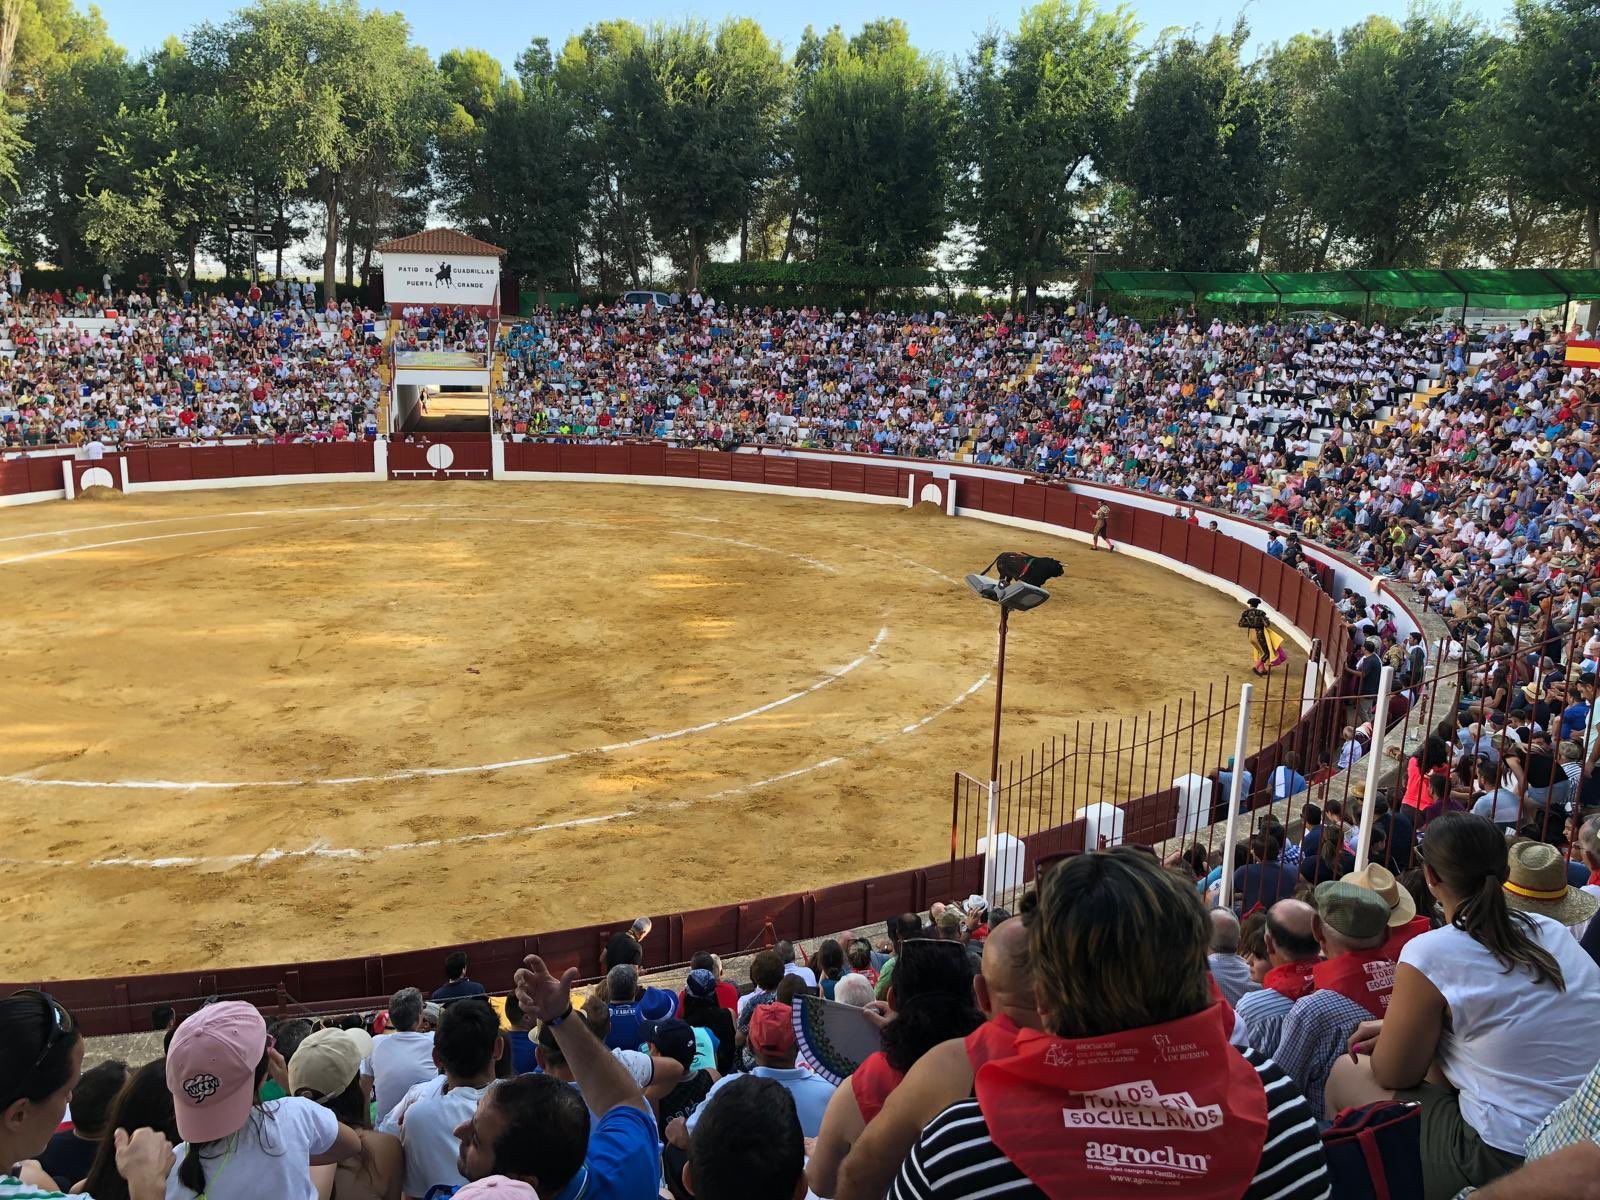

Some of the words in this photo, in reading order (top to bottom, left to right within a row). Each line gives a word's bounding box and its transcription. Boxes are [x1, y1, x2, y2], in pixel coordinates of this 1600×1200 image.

[1168, 1054, 1178, 1062] DE
[1160, 1096, 1190, 1111] EN
[1071, 1109, 1218, 1129] SOCUELLAMOS
